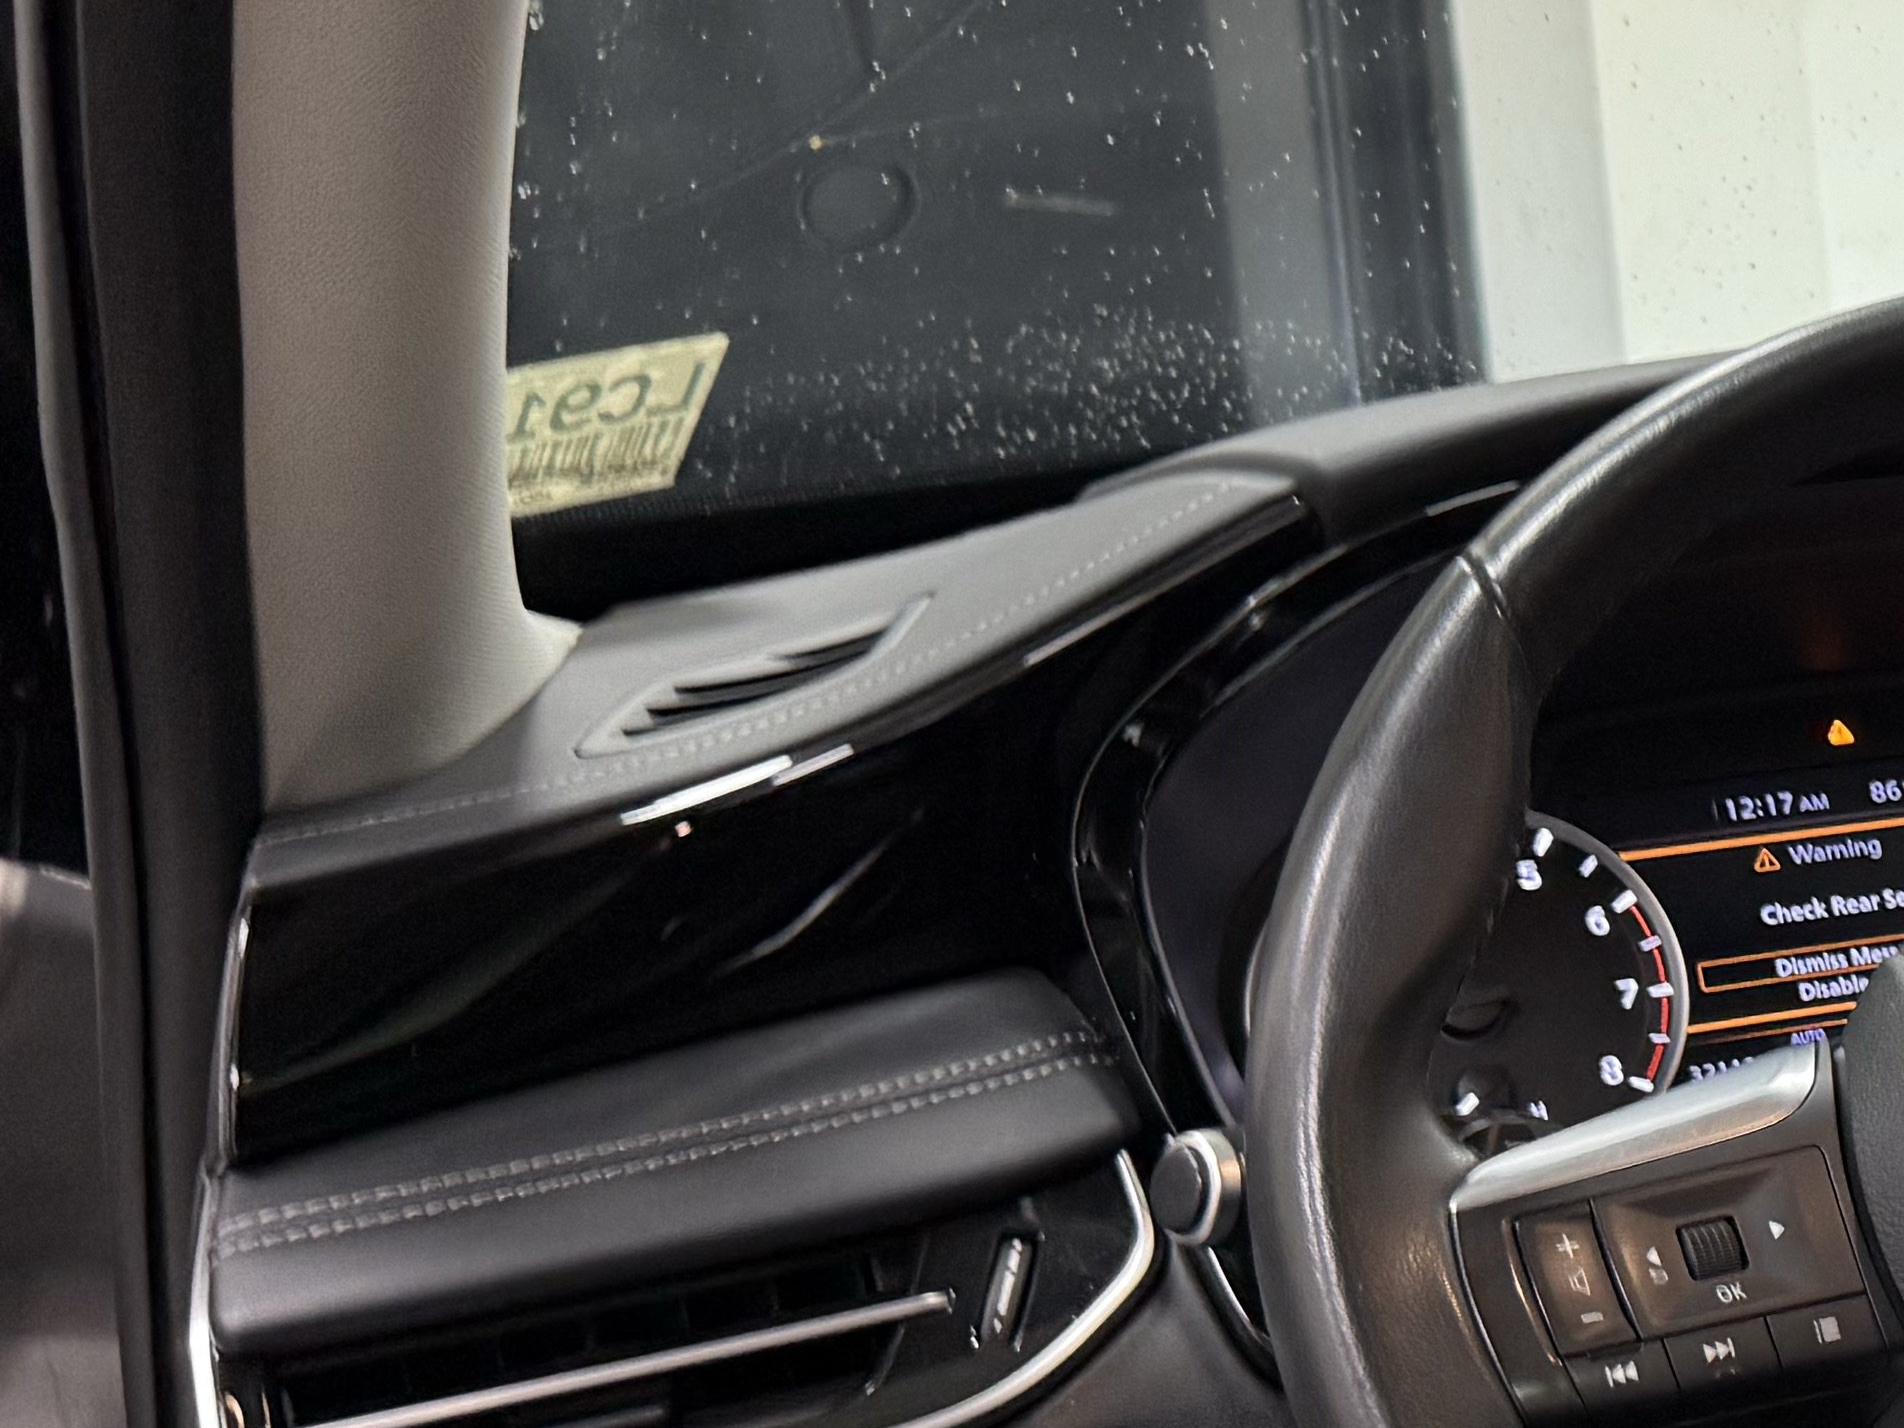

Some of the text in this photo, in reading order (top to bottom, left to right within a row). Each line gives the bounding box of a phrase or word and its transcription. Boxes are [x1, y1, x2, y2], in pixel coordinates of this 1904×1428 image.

[1724, 790, 1793, 822] 12:17
[1799, 793, 1831, 812] AM
[1787, 838, 1883, 865] Warning
[1517, 859, 1543, 891] 5
[1585, 905, 1611, 937] 6
[1760, 896, 1830, 926] Check
[1829, 893, 1881, 918] Rear
[1775, 950, 1849, 978] Dismiss
[1614, 977, 1639, 1010] 7
[1799, 973, 1869, 1002] Disable
[1600, 1055, 1624, 1086] 8
[1716, 1283, 1747, 1304] OK
